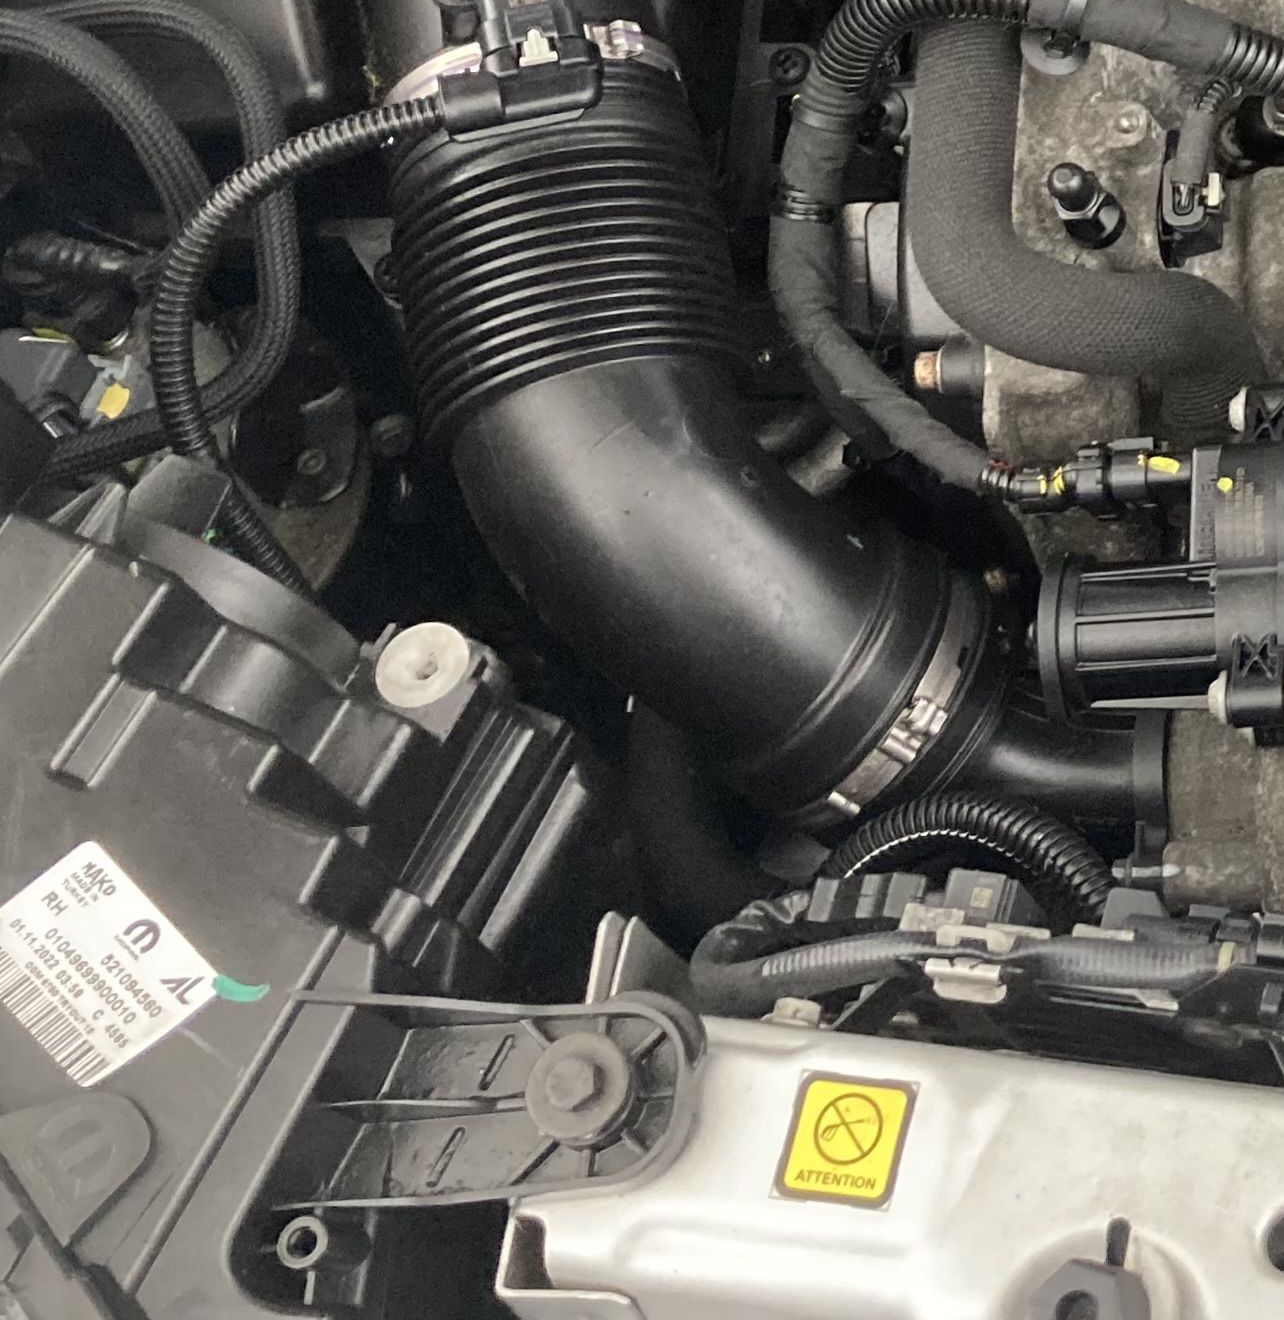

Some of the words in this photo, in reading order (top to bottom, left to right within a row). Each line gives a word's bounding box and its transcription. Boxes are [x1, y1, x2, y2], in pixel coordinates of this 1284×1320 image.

[61, 879, 91, 908] TURKEY
[71, 872, 92, 894] MADE
[41, 891, 68, 916] RH
[92, 1009, 105, 1021] C
[793, 1168, 877, 1192] ATTENTION
